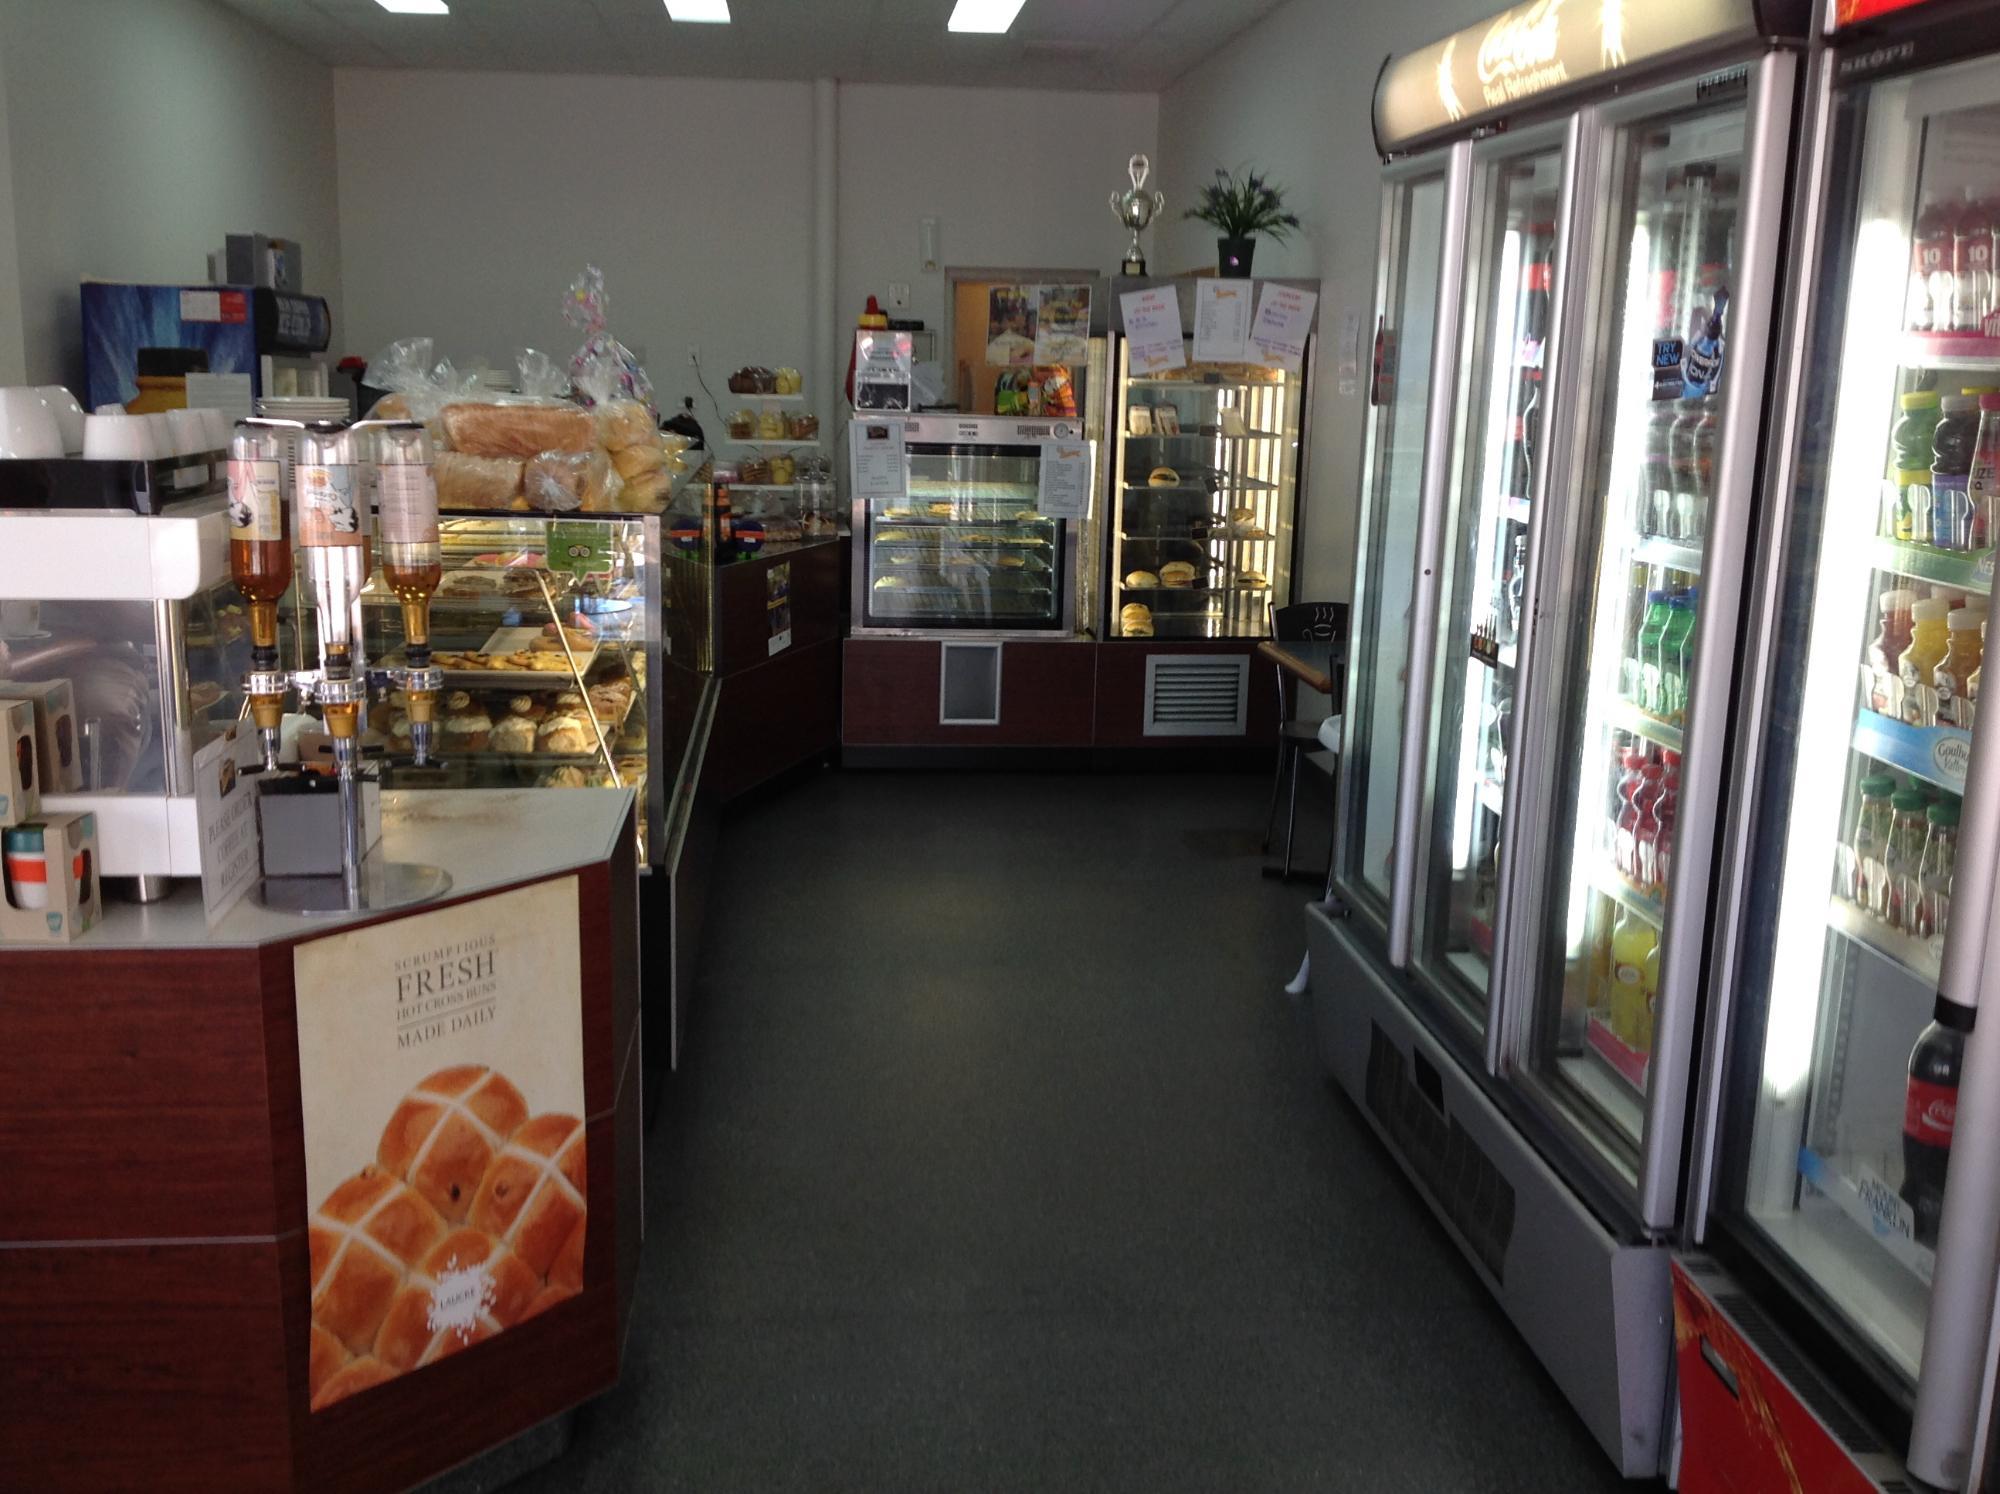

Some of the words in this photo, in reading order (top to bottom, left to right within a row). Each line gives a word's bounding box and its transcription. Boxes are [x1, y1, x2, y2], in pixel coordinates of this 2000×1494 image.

[1483, 81, 1508, 108] Real
[1922, 247, 1941, 265] 10
[1968, 245, 1989, 263] 10
[1656, 352, 1680, 367] NEW
[1657, 342, 1677, 354] TRY
[1938, 742, 1968, 762] Goulbu
[1943, 756, 1967, 775] Valle
[395, 933, 496, 973] SCRUMPTIOUS
[397, 951, 494, 1001] FRESH
[397, 1001, 422, 1021] HOT
[424, 990, 464, 1011] CROSS
[466, 980, 497, 1000] BUNS
[398, 1023, 445, 1048] MADE
[450, 1004, 496, 1032] DAILY
[1857, 1176, 1911, 1239] FRANKLIN
